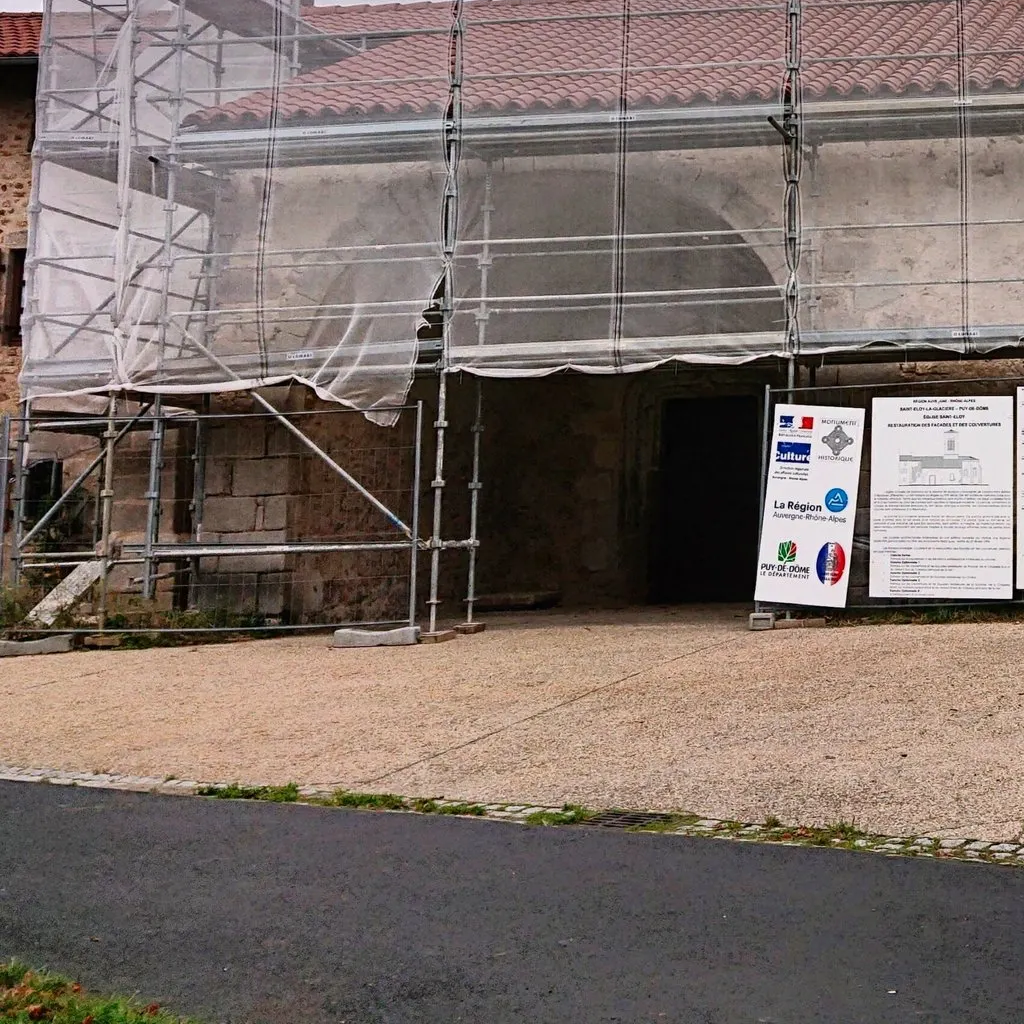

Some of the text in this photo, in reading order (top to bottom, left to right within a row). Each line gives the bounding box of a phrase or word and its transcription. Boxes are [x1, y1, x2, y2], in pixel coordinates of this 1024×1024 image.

[775, 451, 812, 462] Culture
[774, 500, 822, 513] La Région
[772, 512, 847, 523] Auvergne-Rhône-Alpes
[760, 563, 811, 574] PUY-DE-DÔME
[768, 571, 810, 579] DÉPARTEMENT
